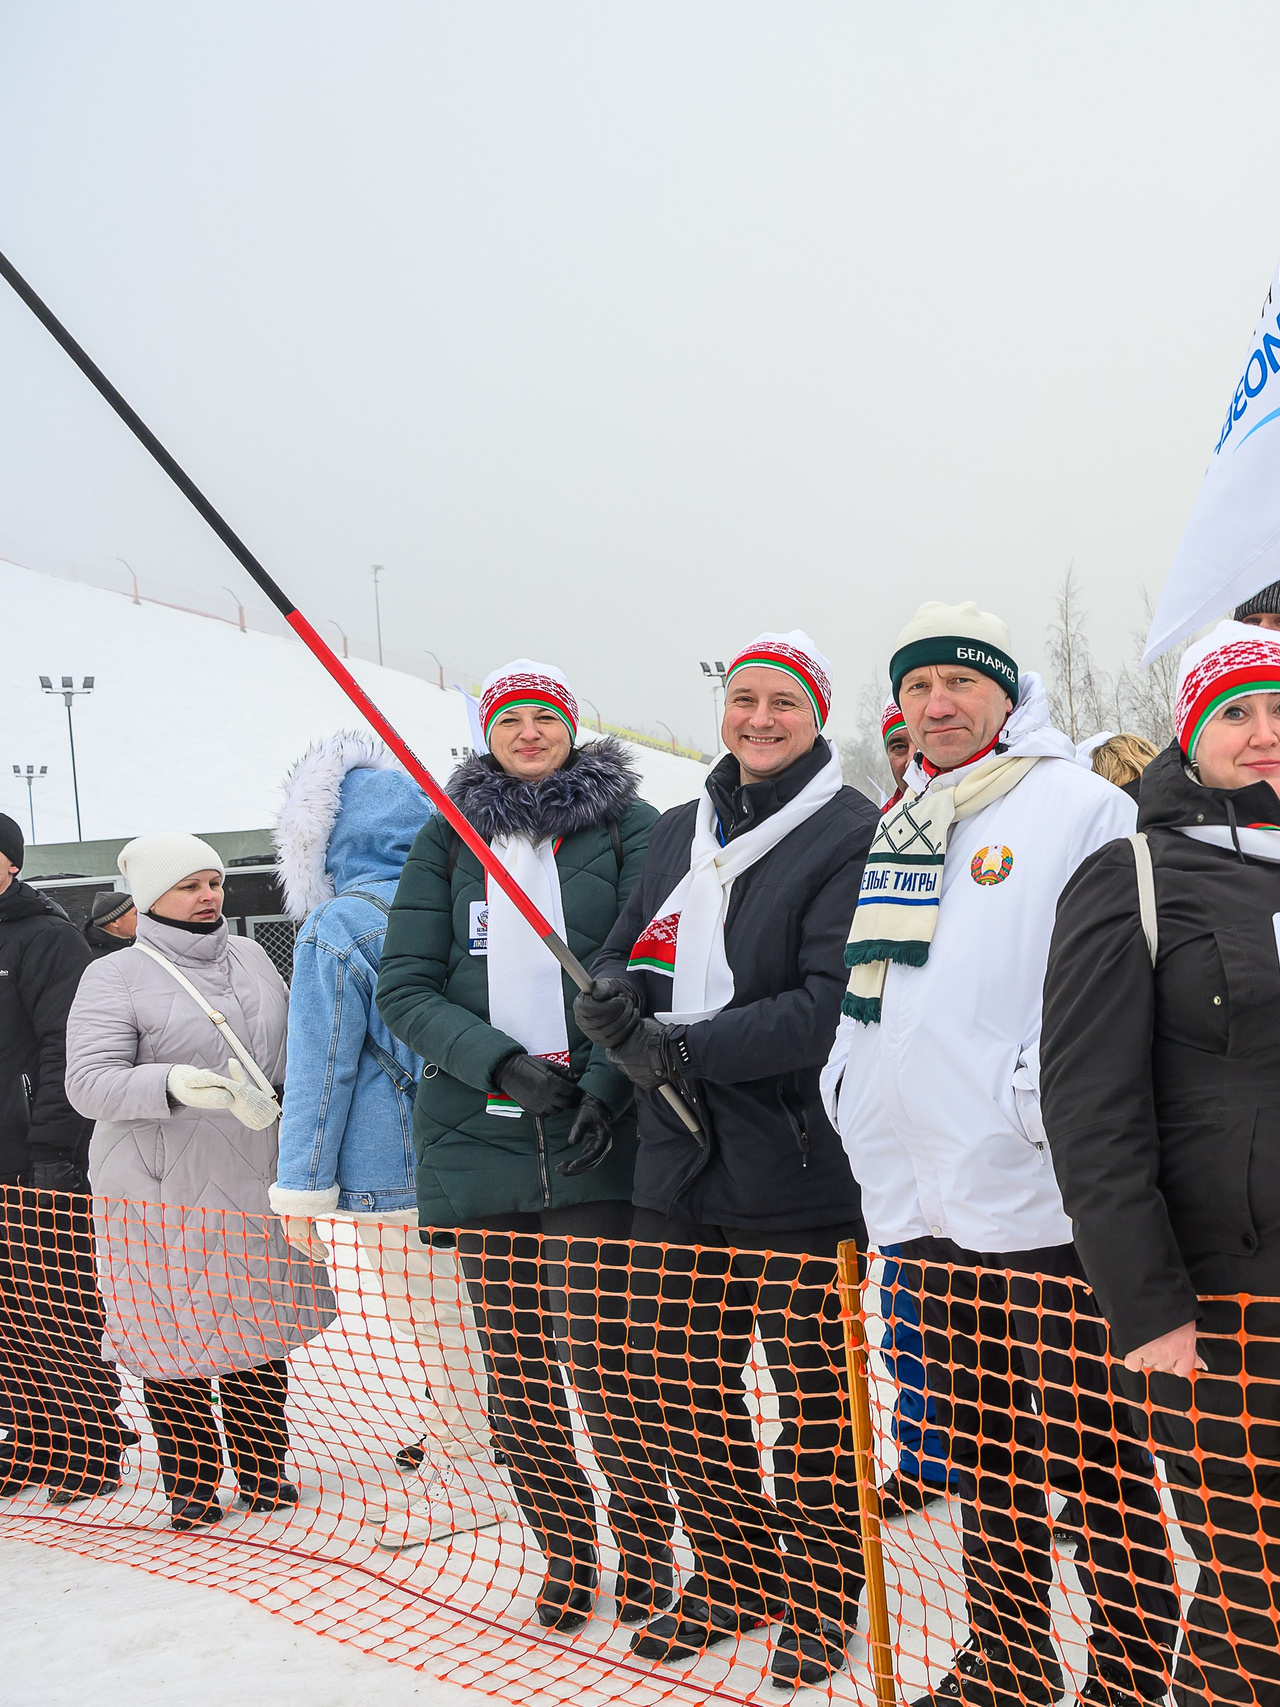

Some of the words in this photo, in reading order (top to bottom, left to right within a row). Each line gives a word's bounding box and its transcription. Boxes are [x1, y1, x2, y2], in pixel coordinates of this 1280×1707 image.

[957, 647, 1016, 683] БЕЛАРУСЬ
[861, 870, 891, 891] ЕЛЫЕ
[893, 871, 938, 892] ТИГРЫ
[473, 940, 487, 948] ЛЮД
